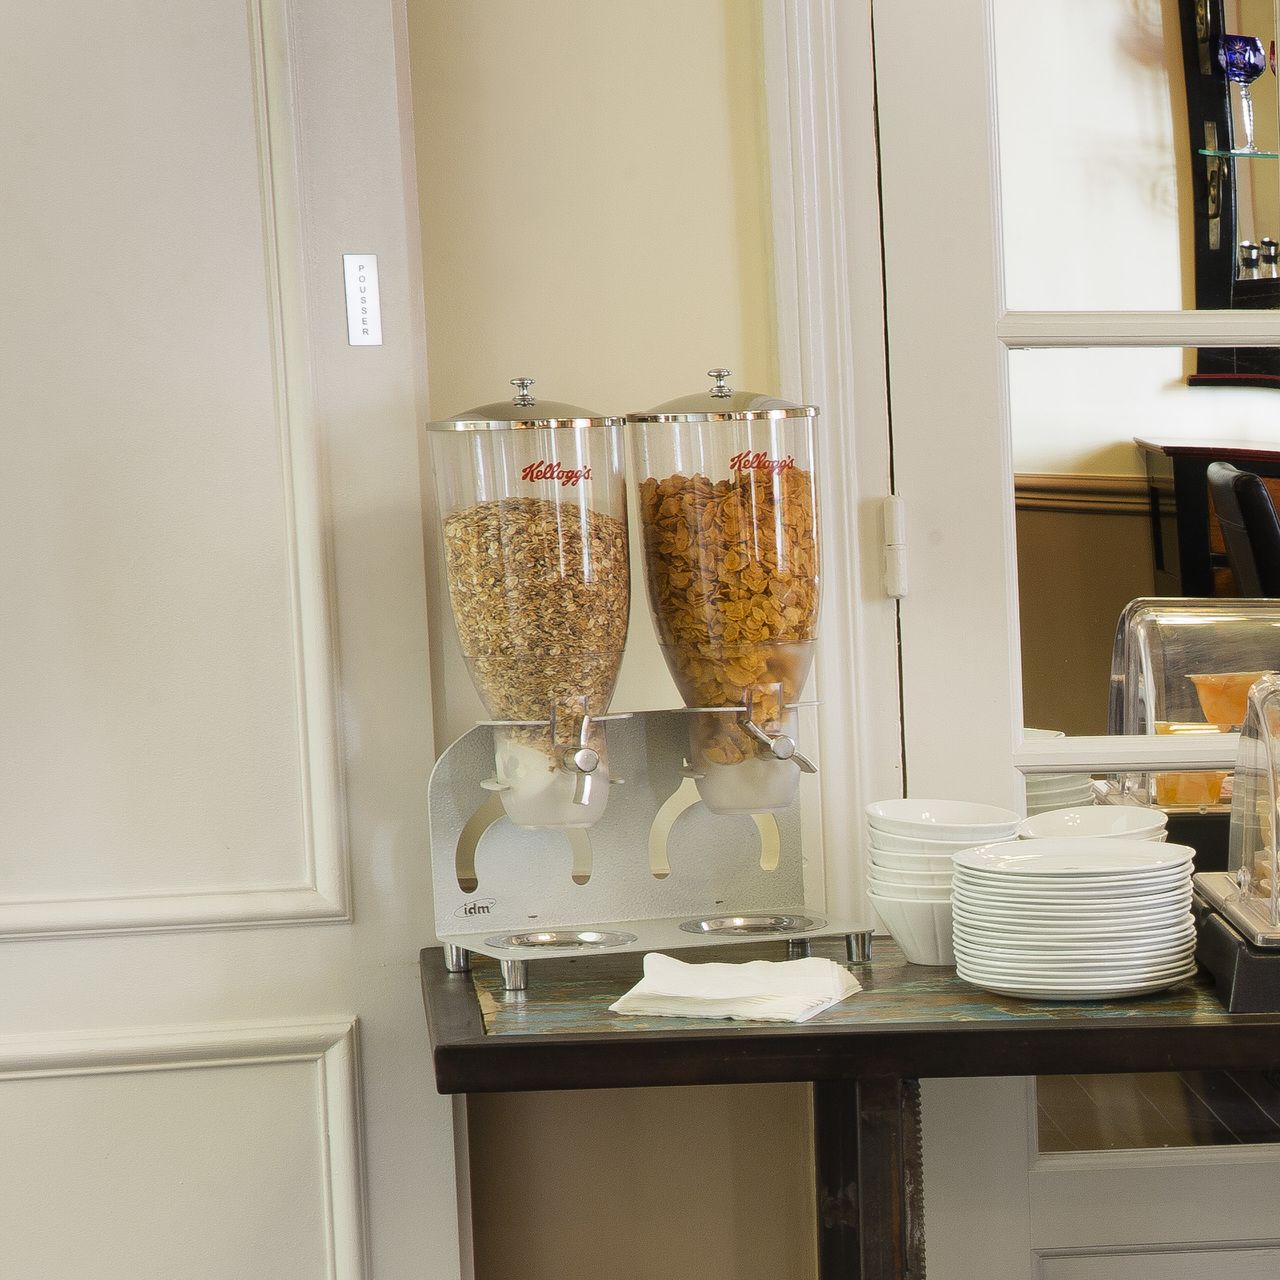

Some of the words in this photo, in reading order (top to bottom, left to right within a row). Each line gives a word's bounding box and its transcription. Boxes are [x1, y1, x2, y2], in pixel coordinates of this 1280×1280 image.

[358, 264, 369, 336] POUSSER
[521, 460, 592, 487] Kellogg's
[730, 450, 795, 476] Kellogg's
[464, 903, 491, 915] idm
